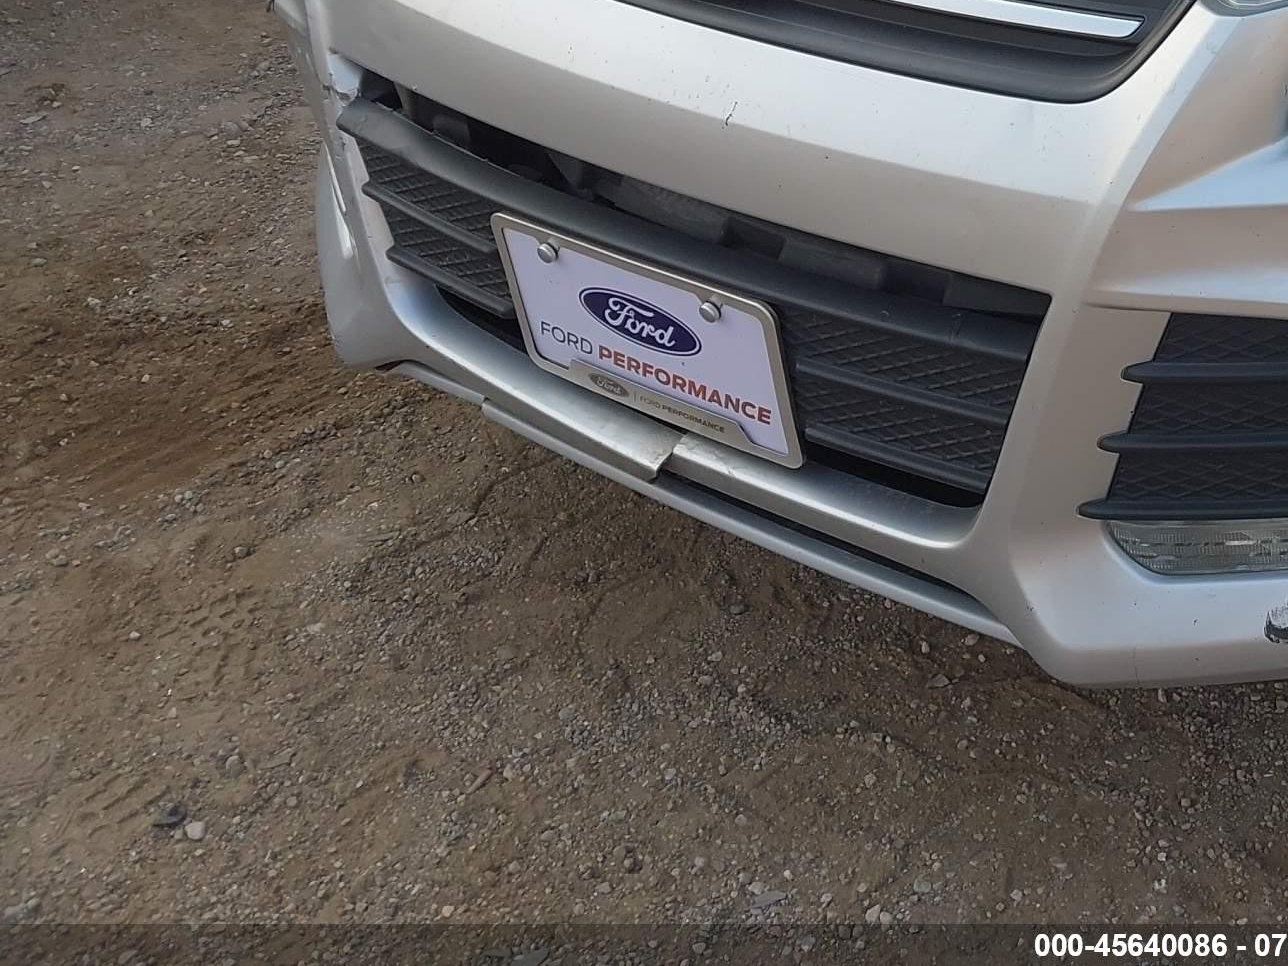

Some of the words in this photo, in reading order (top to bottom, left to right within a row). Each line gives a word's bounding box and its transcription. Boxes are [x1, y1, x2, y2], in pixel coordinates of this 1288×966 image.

[605, 297, 675, 347] Ford
[540, 321, 593, 354] FORD
[599, 345, 771, 424] PERFORMANCE
[598, 377, 622, 395] Ford
[662, 404, 725, 433] PERFORMANCE
